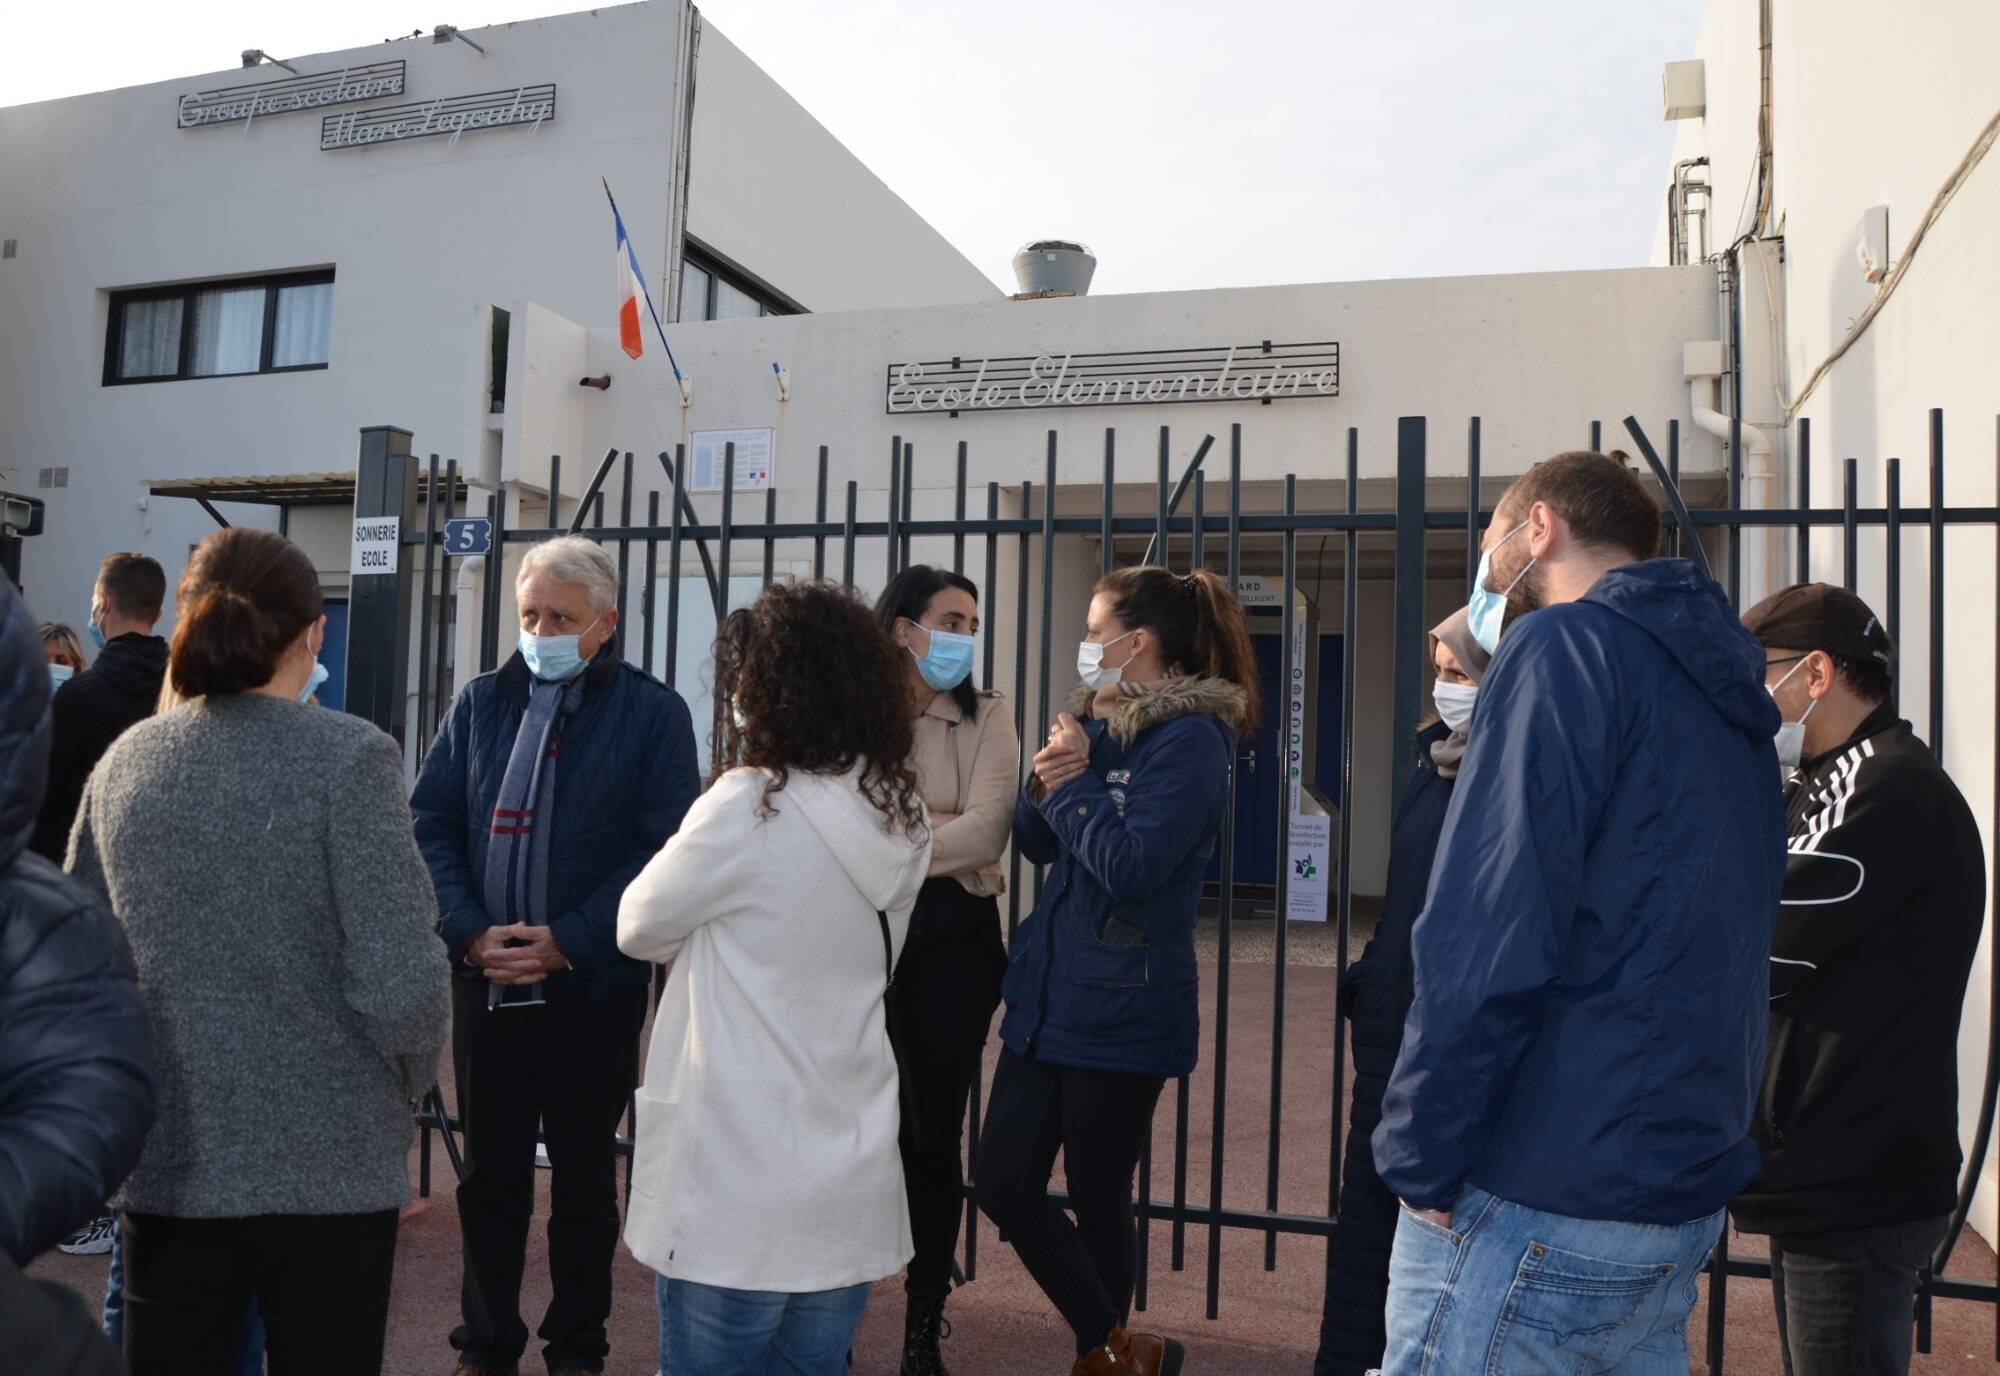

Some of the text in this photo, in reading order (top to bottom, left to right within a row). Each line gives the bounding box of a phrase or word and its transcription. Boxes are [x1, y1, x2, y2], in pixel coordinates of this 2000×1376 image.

[180, 68, 404, 135] Groupe scolaire
[321, 87, 553, 149] Marc Legouhy
[355, 525, 396, 542] SONNERIE
[459, 524, 475, 549] 5
[361, 550, 388, 567] ECOLE
[1238, 582, 1260, 591] ARD
[1290, 822, 1323, 832] Tunnel de
